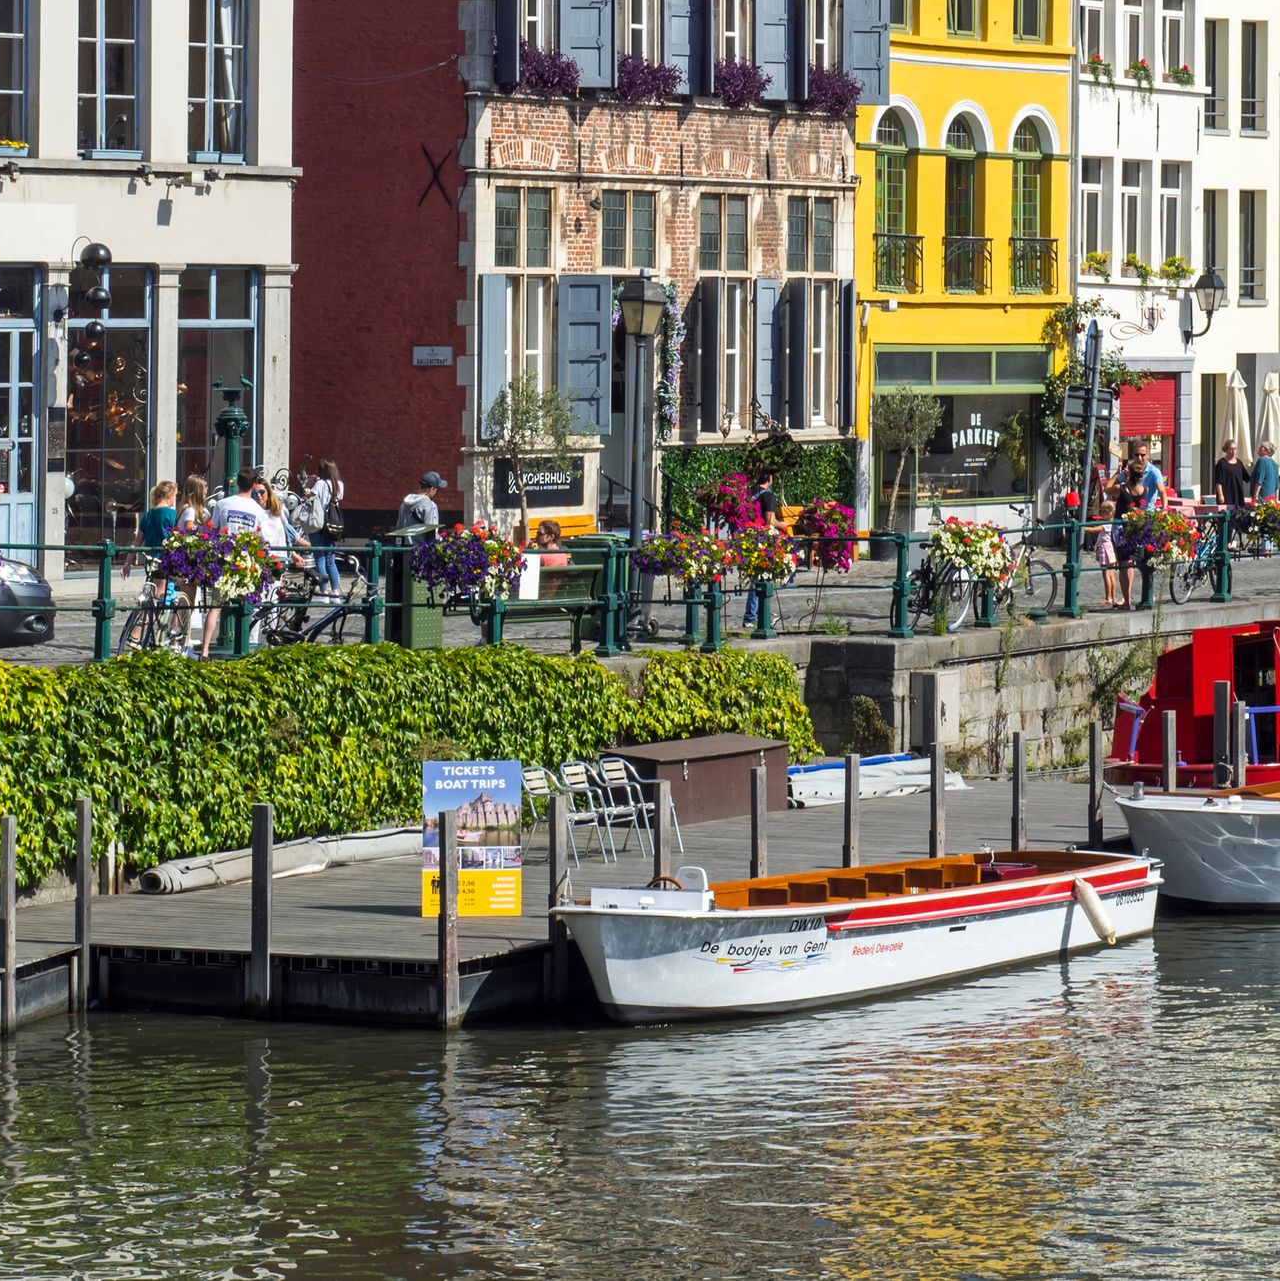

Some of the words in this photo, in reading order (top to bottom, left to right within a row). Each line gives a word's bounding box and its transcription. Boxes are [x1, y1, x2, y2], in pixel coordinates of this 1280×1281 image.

[971, 413, 981, 426] DE
[951, 428, 1000, 449] PARKIET
[523, 472, 570, 485] KOPERHUIS
[442, 766, 495, 776] TICKETS
[435, 780, 469, 790] BOAT
[470, 779, 506, 789] TRIPS
[789, 918, 821, 933] DW10
[700, 941, 719, 954] De
[727, 939, 772, 967] bootjes
[779, 944, 797, 956] van
[803, 940, 828, 953] Gent
[851, 944, 876, 957] Rederij
[875, 941, 904, 955] Dewaele
